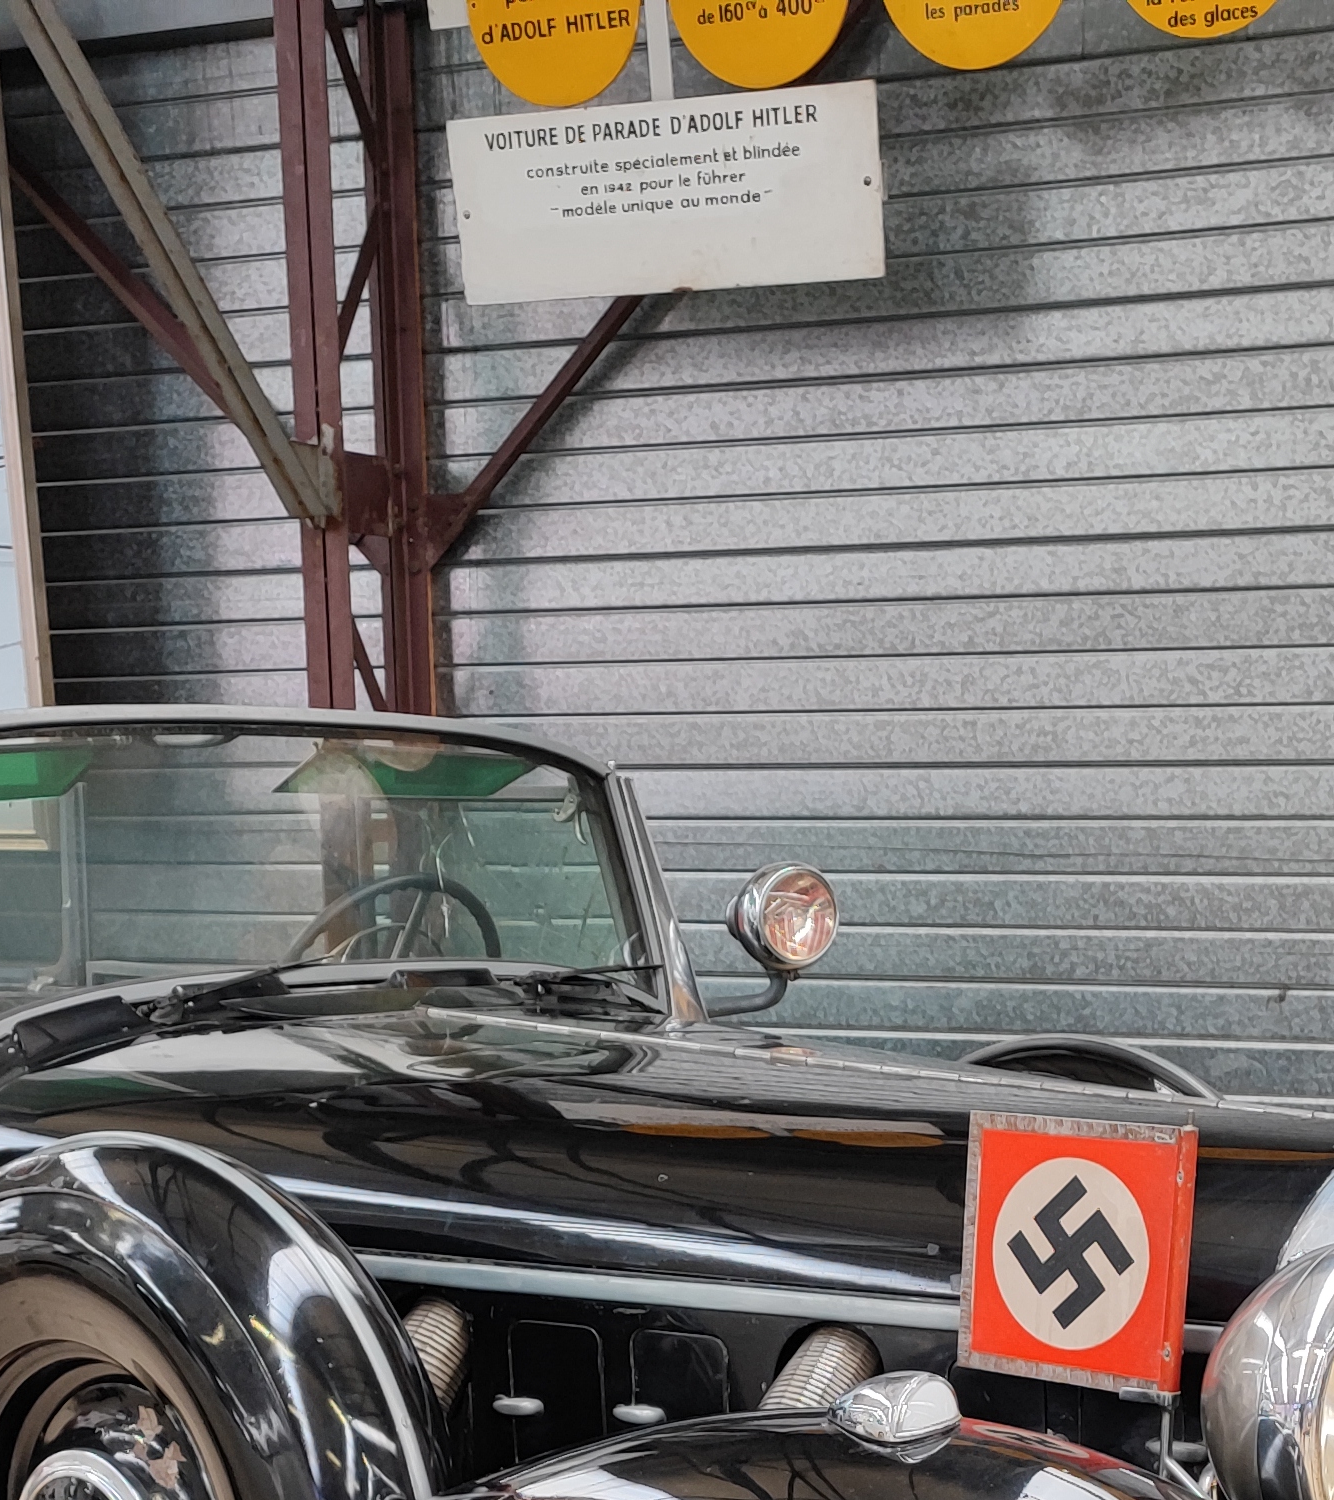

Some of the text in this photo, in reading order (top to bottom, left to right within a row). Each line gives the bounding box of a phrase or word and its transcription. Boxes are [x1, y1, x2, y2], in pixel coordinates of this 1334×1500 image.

[697, 9, 715, 25] de
[776, 0, 825, 17] 400
[925, 0, 1020, 22] les parades
[1168, 4, 1258, 28] des glaces
[482, 9, 631, 45] d'ADOLF HITLER
[484, 104, 819, 152] VOITURE DE PARADE D'ADOLF HITLER
[526, 142, 802, 180] construite spécialement et blindée
[580, 184, 599, 196] en
[603, 182, 633, 194] 1942
[639, 177, 674, 194] pour
[678, 173, 691, 188] le
[621, 197, 674, 214] unique
[680, 196, 700, 209] au
